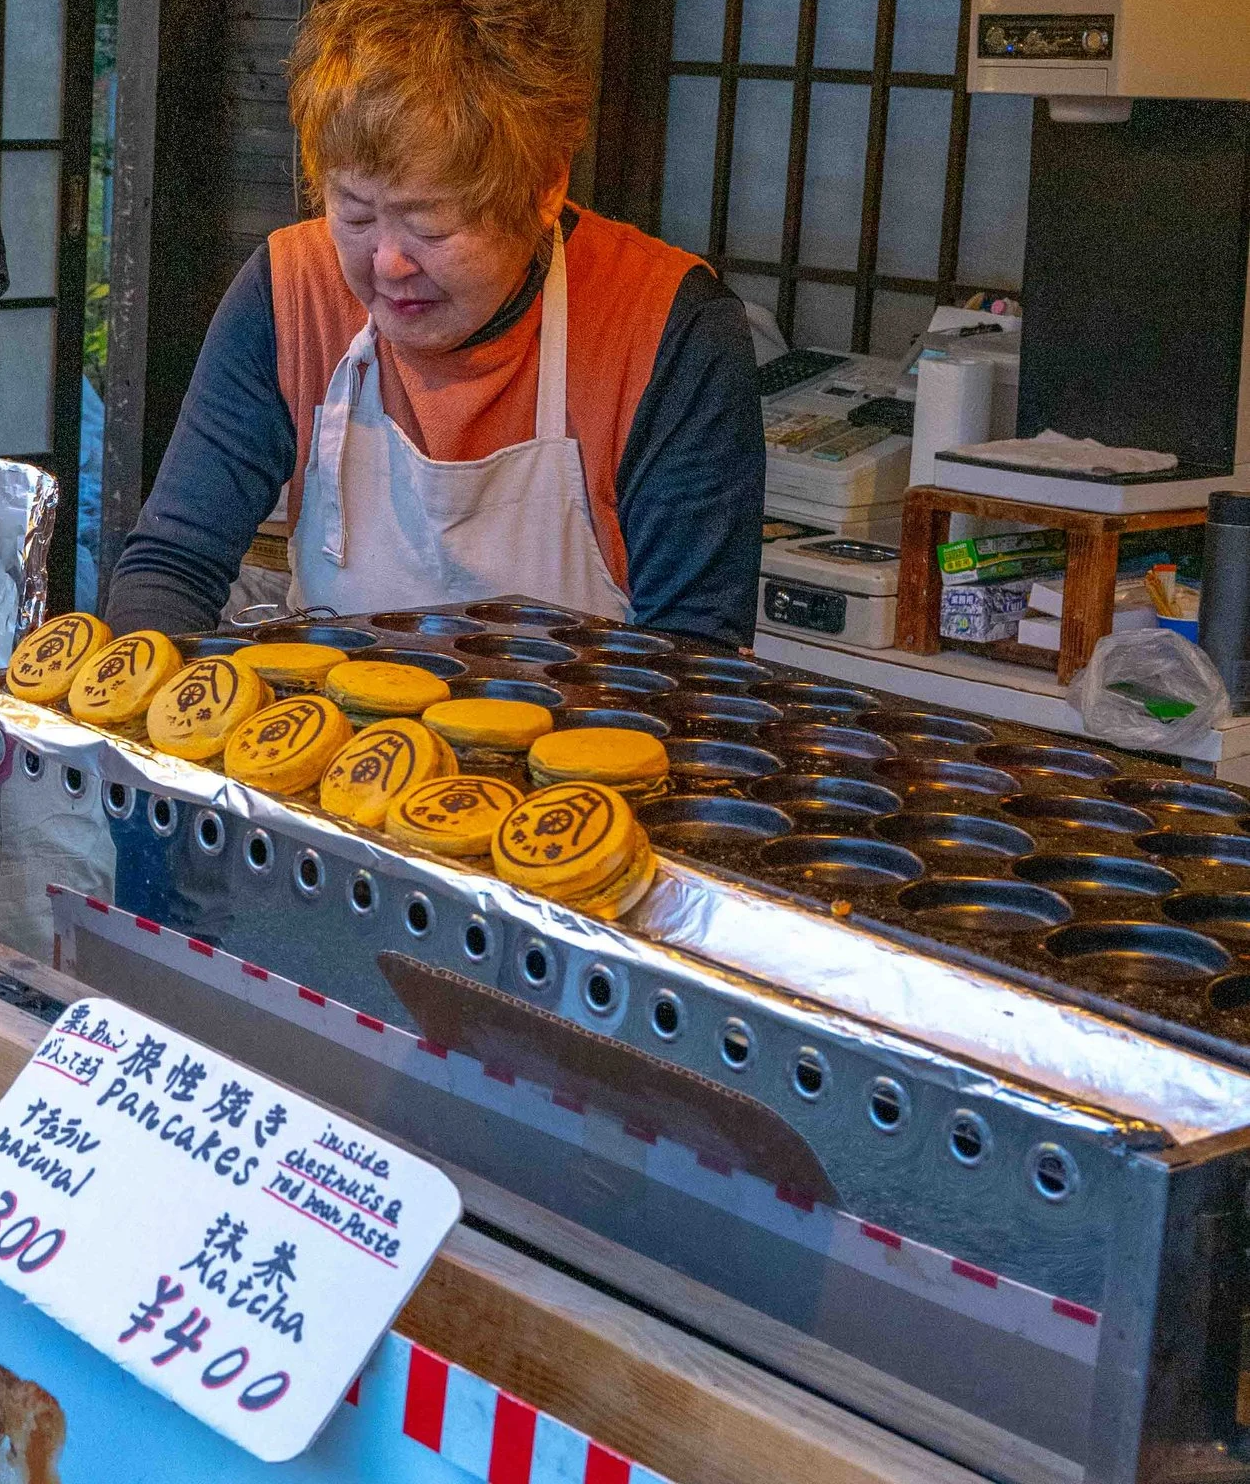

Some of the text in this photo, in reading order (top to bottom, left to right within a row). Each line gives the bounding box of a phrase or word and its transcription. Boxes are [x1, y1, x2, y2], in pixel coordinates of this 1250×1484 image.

[20, 1097, 101, 1154] ナチュラル
[319, 1122, 390, 1180] inside
[269, 1170, 306, 1201] red
[284, 1147, 384, 1212] chestnuts
[204, 1211, 297, 1294] 抹茶
[178, 1249, 305, 1344] Matcha
[117, 1274, 292, 1413] ¥400
